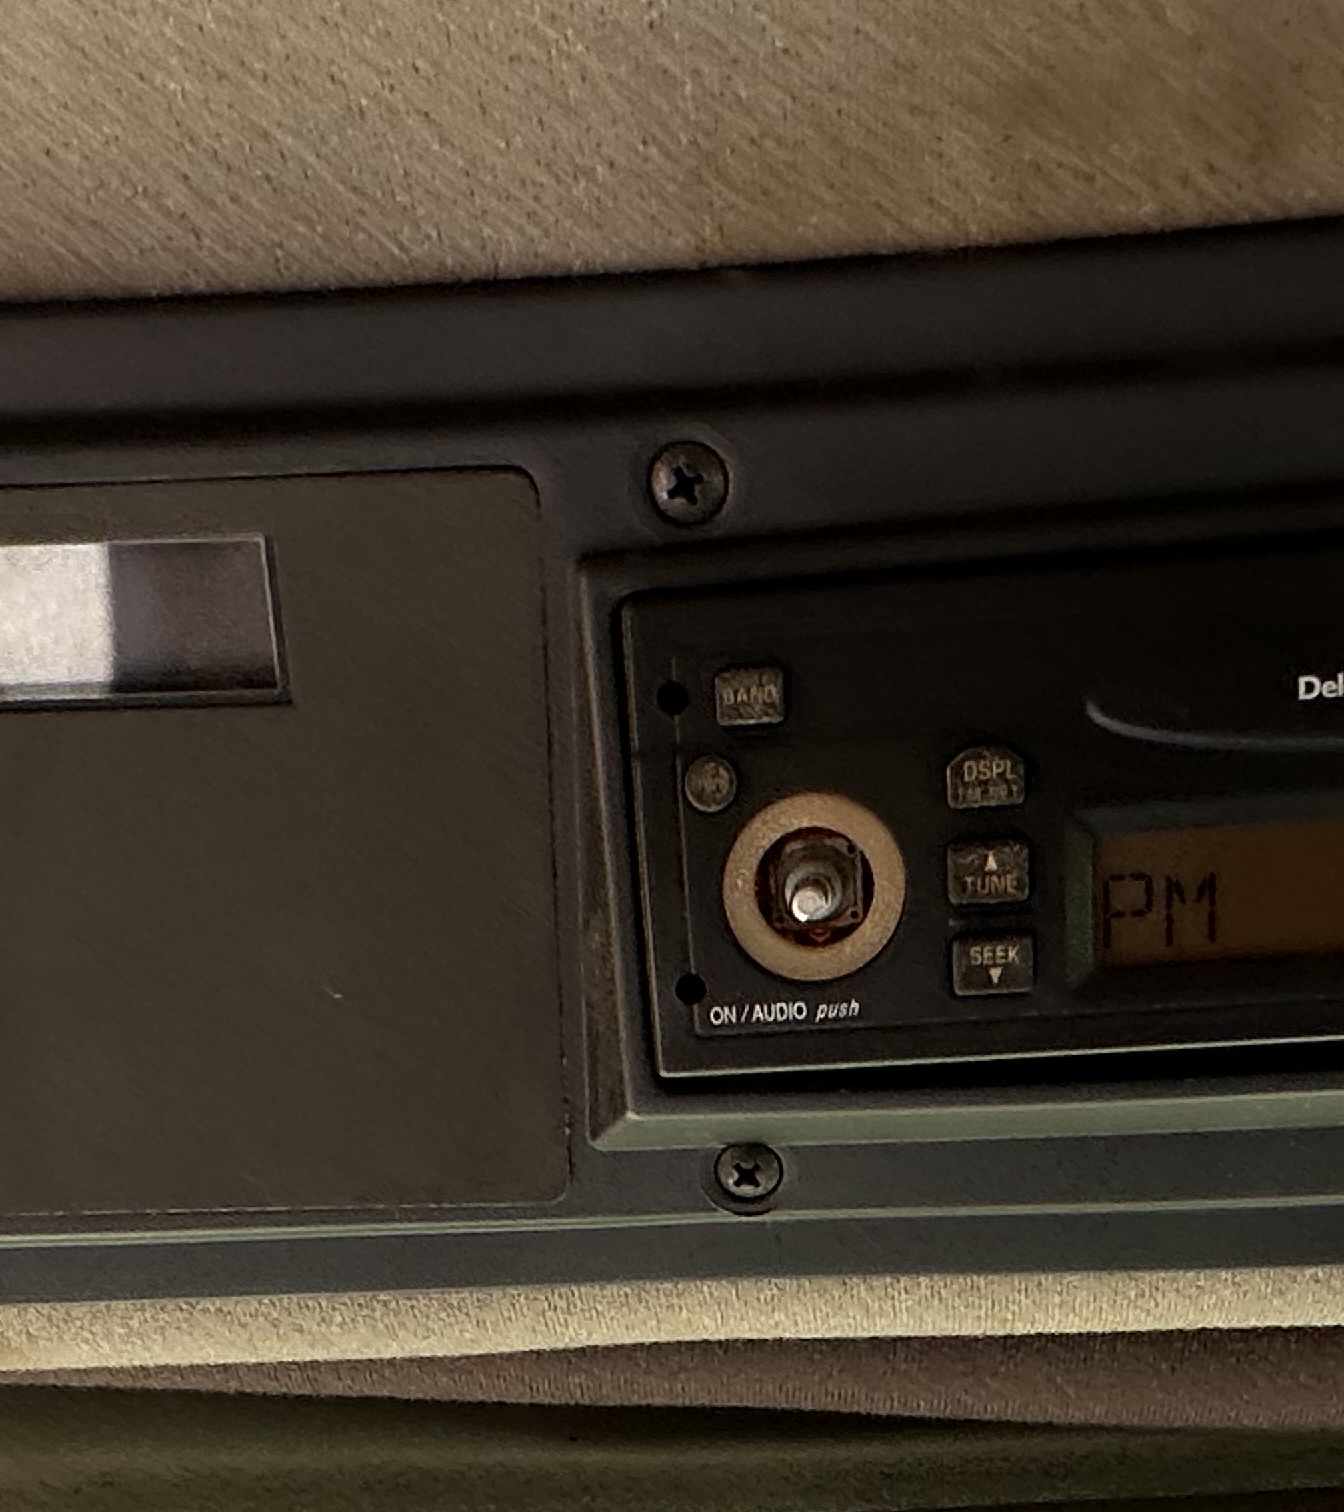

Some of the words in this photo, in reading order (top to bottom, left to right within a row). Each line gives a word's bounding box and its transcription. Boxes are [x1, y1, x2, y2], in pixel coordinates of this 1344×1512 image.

[962, 758, 1019, 783] DSPL
[962, 872, 1019, 898] TUNE
[1102, 871, 1219, 948] PM
[968, 944, 1021, 967] SEEK
[814, 998, 861, 1024] push
